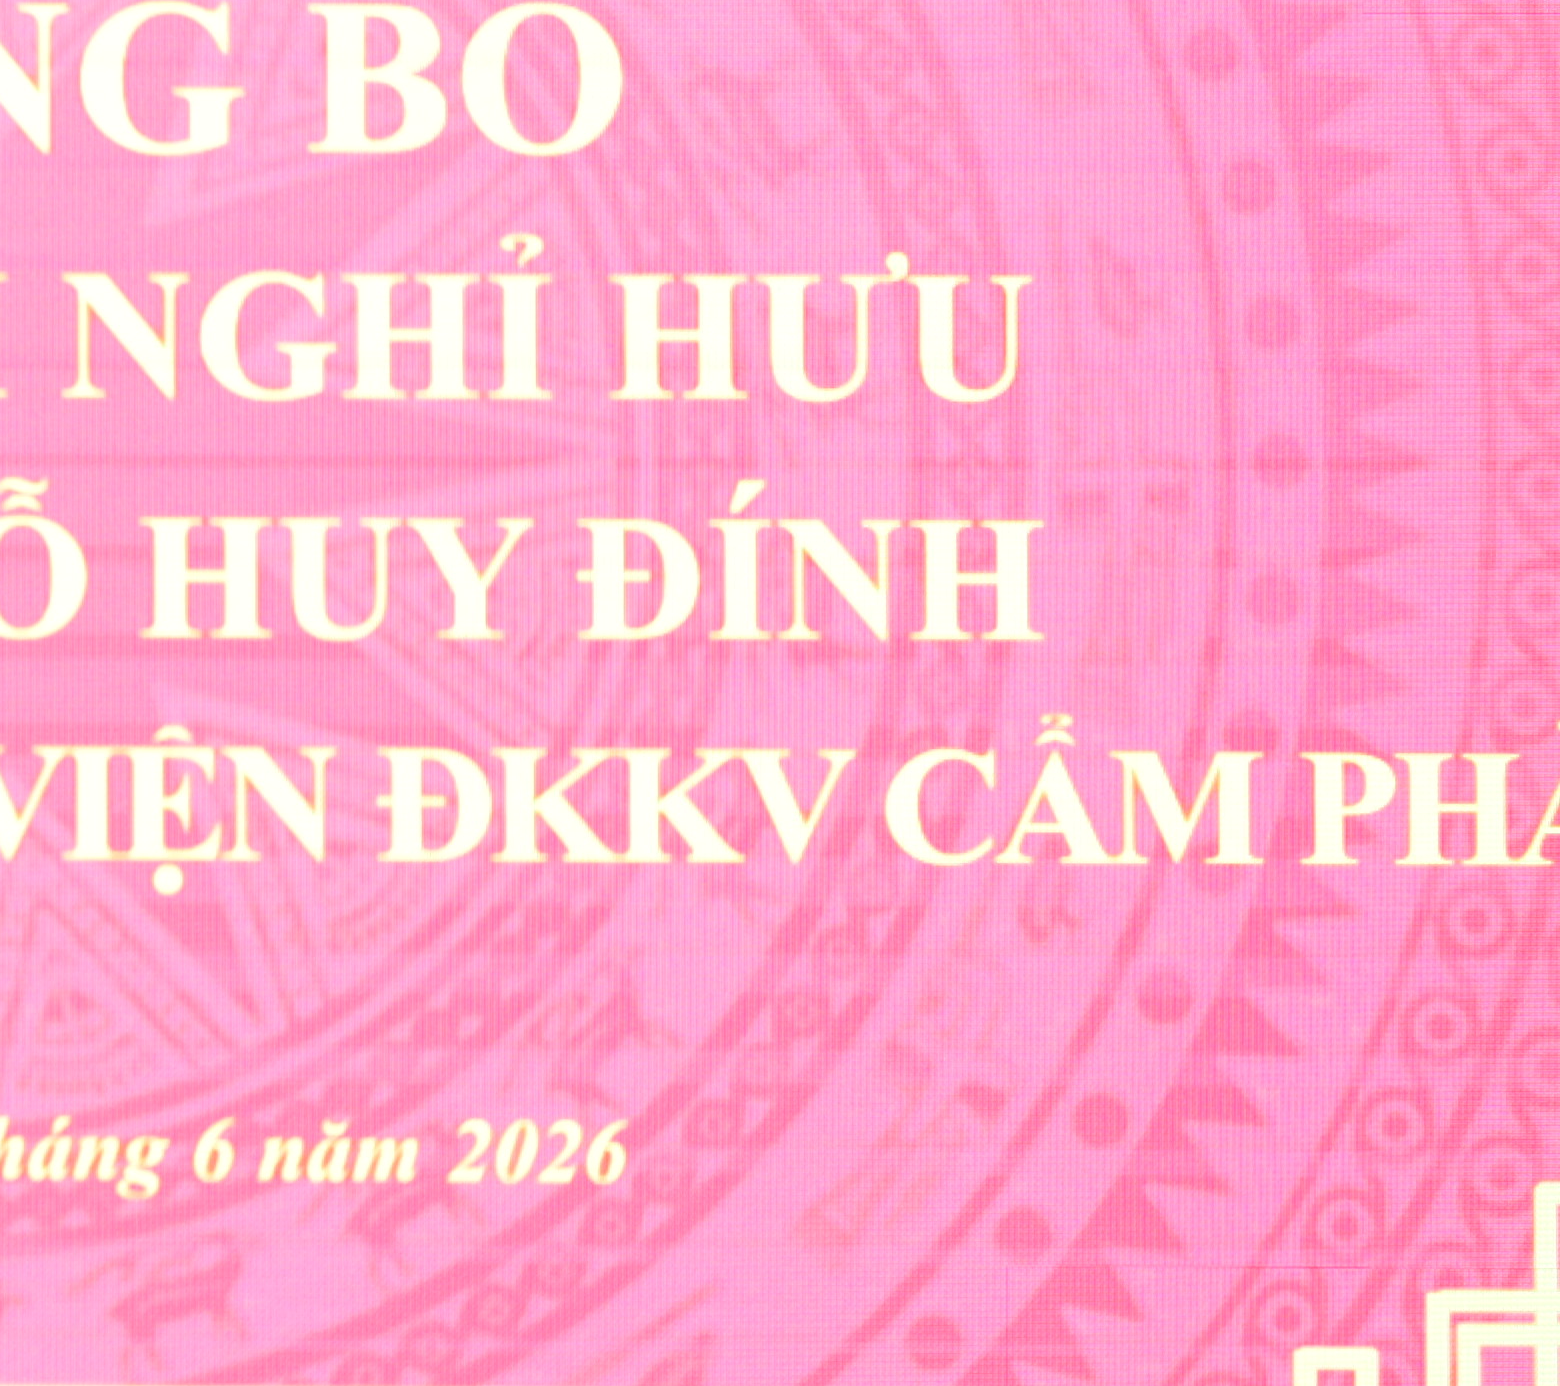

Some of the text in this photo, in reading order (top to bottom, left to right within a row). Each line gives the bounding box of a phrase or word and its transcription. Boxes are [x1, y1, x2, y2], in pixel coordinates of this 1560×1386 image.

[62, 232, 552, 403] NGHỈ
[609, 250, 1034, 403] HƯU
[140, 516, 534, 643] HUY
[576, 479, 1045, 643] ĐÍNH
[375, 745, 857, 865] ĐKKV
[885, 713, 1265, 867] CẨM
[192, 1117, 236, 1183] 6
[257, 1119, 420, 1185] năm
[447, 1117, 628, 1186] 2026
